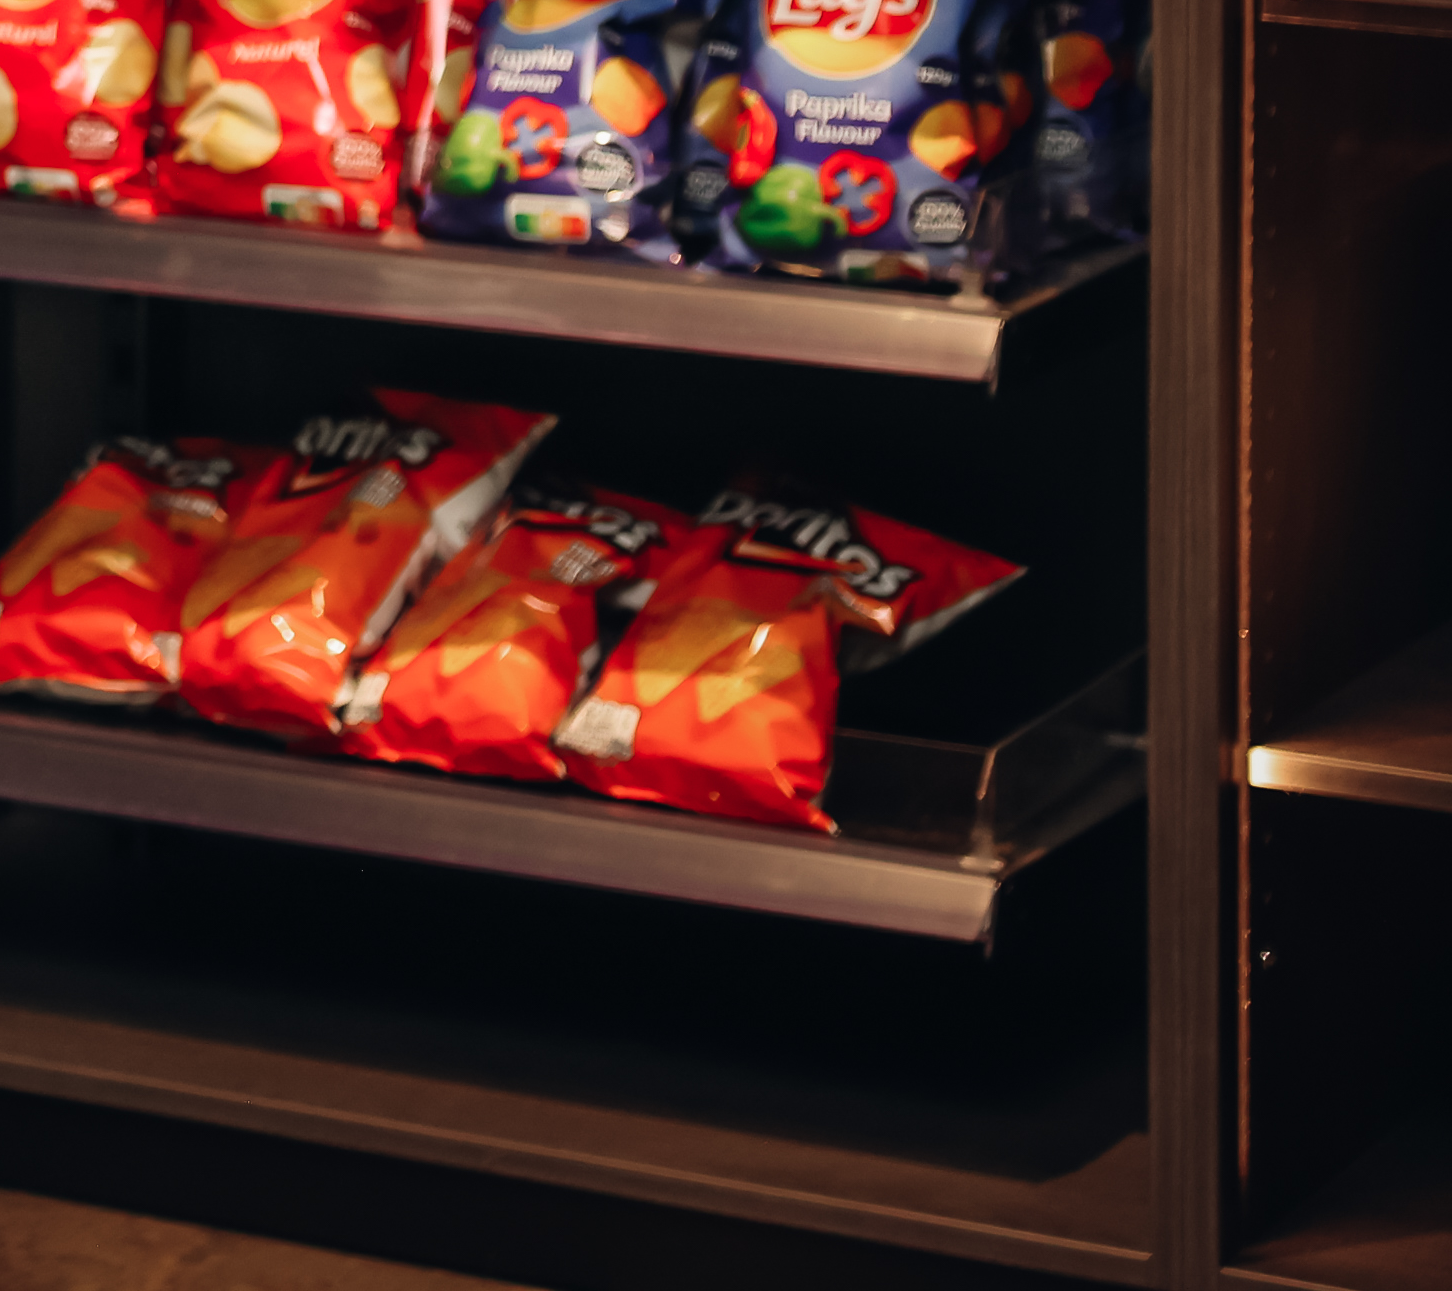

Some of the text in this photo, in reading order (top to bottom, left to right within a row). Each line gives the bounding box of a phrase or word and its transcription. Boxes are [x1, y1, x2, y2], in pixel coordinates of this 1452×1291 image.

[486, 44, 575, 72] Paprika
[785, 89, 893, 124] Paprika
[794, 121, 883, 146] Flavour
[700, 491, 915, 598] Doritos
